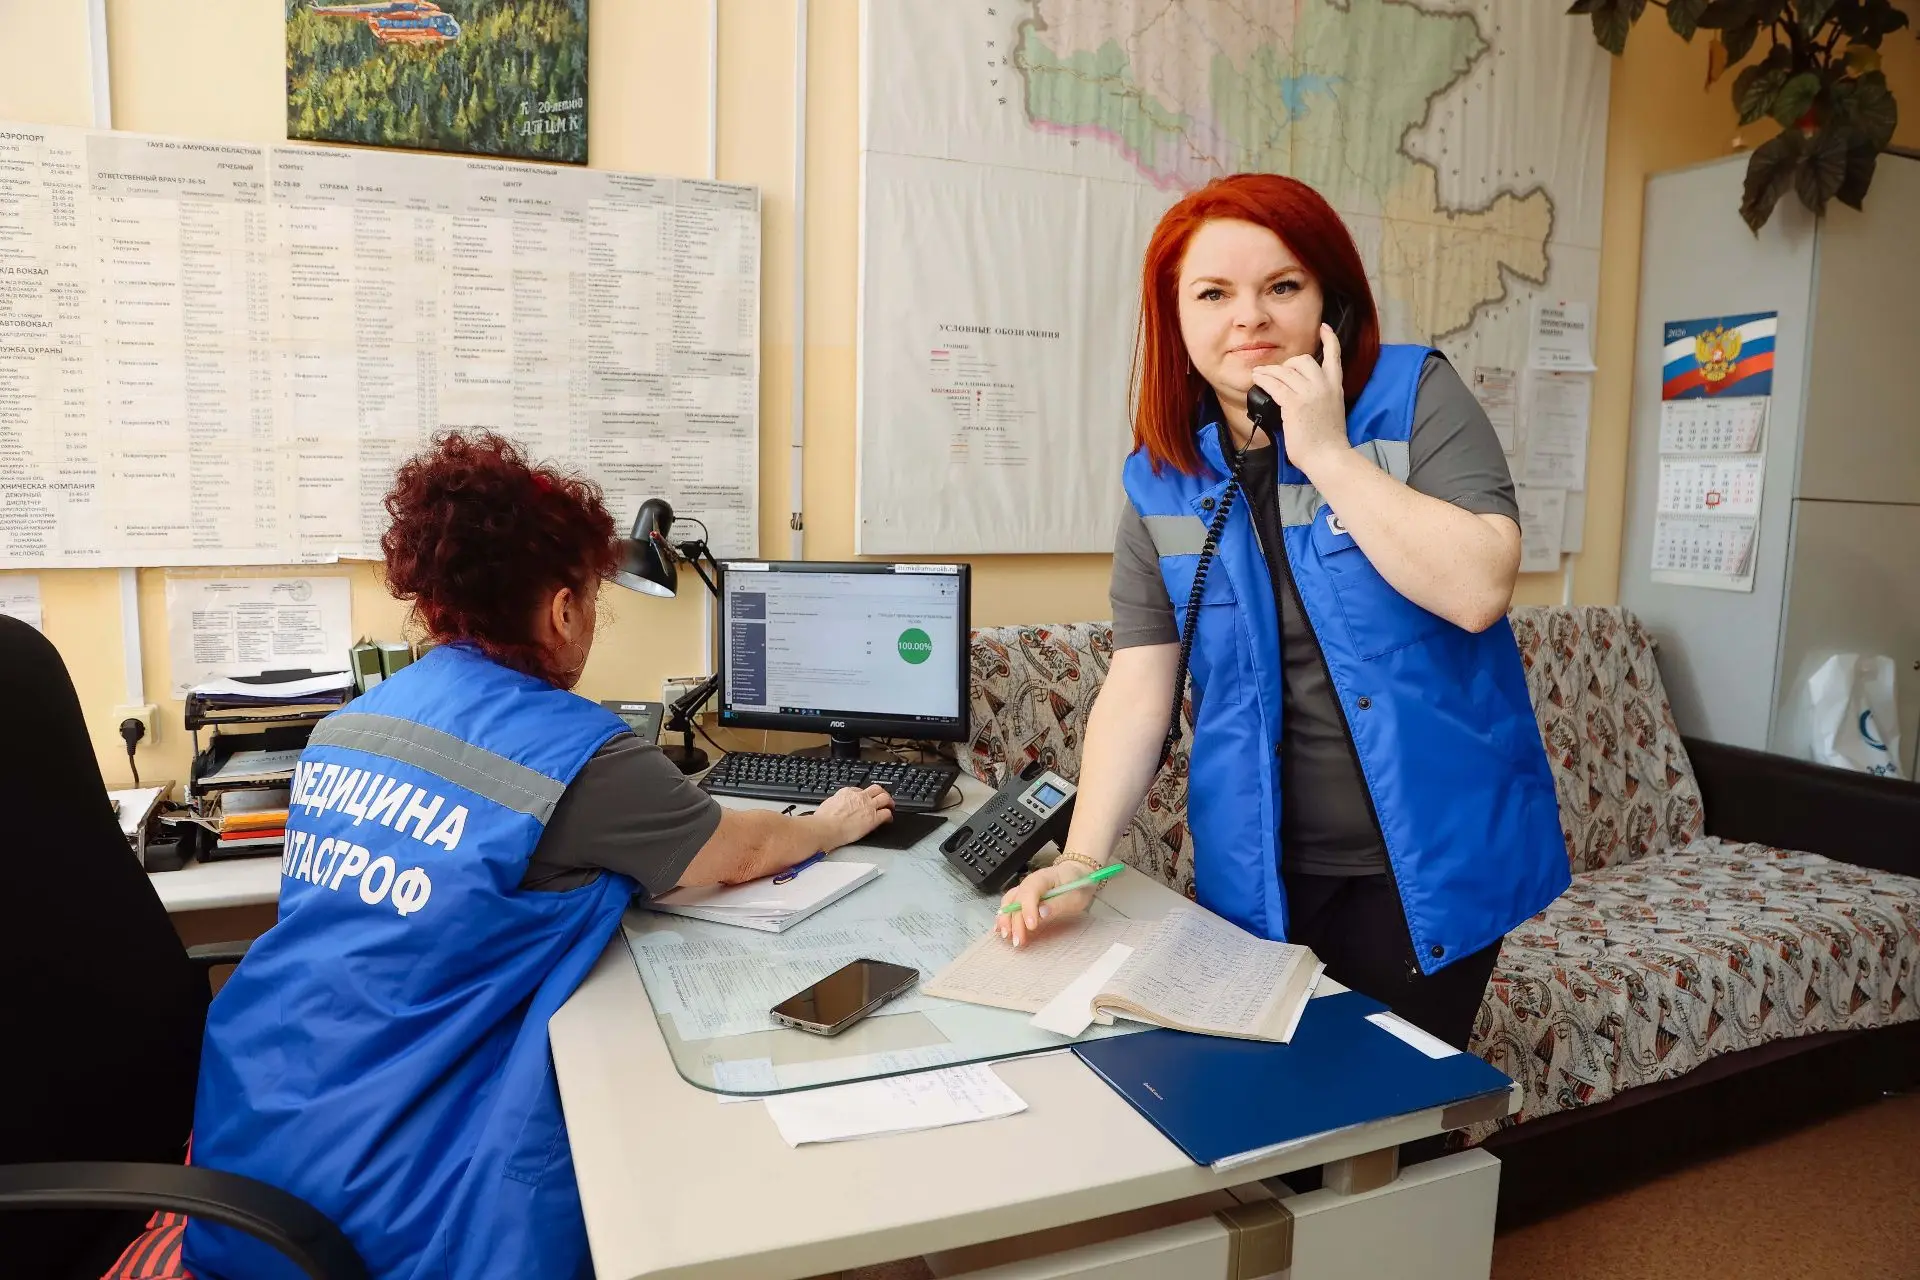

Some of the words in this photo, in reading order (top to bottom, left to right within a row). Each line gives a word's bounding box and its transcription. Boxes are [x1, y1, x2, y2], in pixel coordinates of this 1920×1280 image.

[0, 132, 44, 142] АЭРОПОРТ
[182, 144, 219, 152] АМУРСКАЯ
[221, 146, 262, 156] ОБЛАСТНАЯ
[217, 162, 254, 171] ЛЕЧЕБНЫЙ
[98, 173, 157, 182] ОТВЕТСТВЕННЫЙ
[939, 324, 992, 334] УСЛОВНЫЕ
[995, 328, 1060, 339] ОБОЗНАЧЕНИЯ
[898, 641, 932, 652] 100.00%
[829, 720, 845, 728] AOC
[290, 760, 469, 851] МЕДИЦИНА
